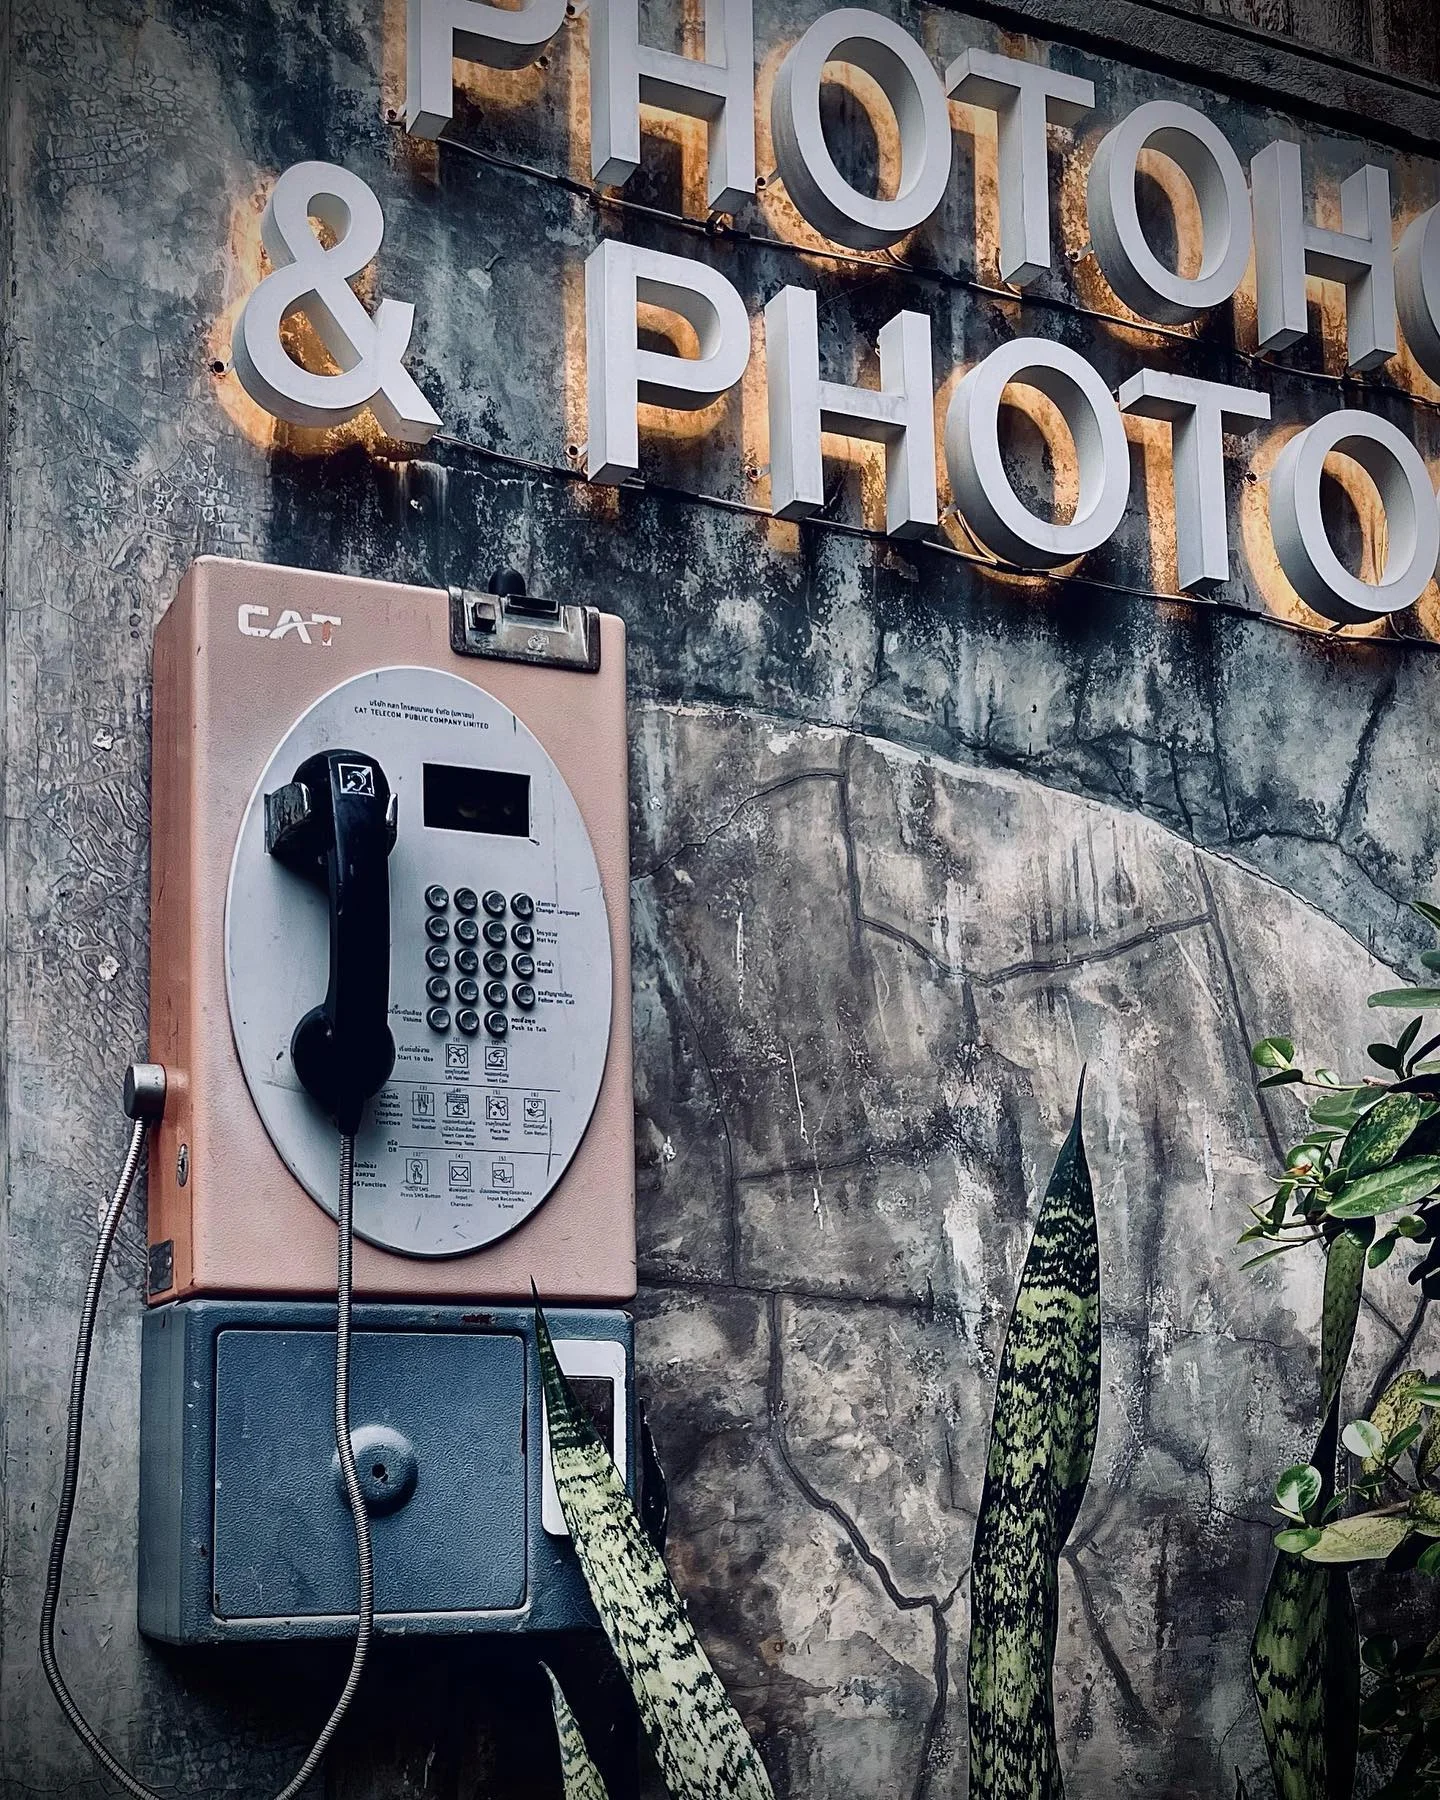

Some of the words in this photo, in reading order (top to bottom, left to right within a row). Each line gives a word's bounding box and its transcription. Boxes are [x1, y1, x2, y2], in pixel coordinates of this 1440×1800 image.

[405, 0, 1440, 386] PHOTOH
[232, 161, 443, 445] &
[585, 238, 1440, 625] PHOTO
[238, 603, 342, 647] CAT
[354, 706, 367, 715] CAT
[370, 708, 402, 719] TELECOM
[404, 713, 429, 723] PUBLIC
[430, 717, 461, 727] COMPANY
[463, 721, 489, 730] LIMITED
[536, 907, 554, 915] Change
[374, 1110, 403, 1118] Telephone
[375, 1118, 401, 1126] Function
